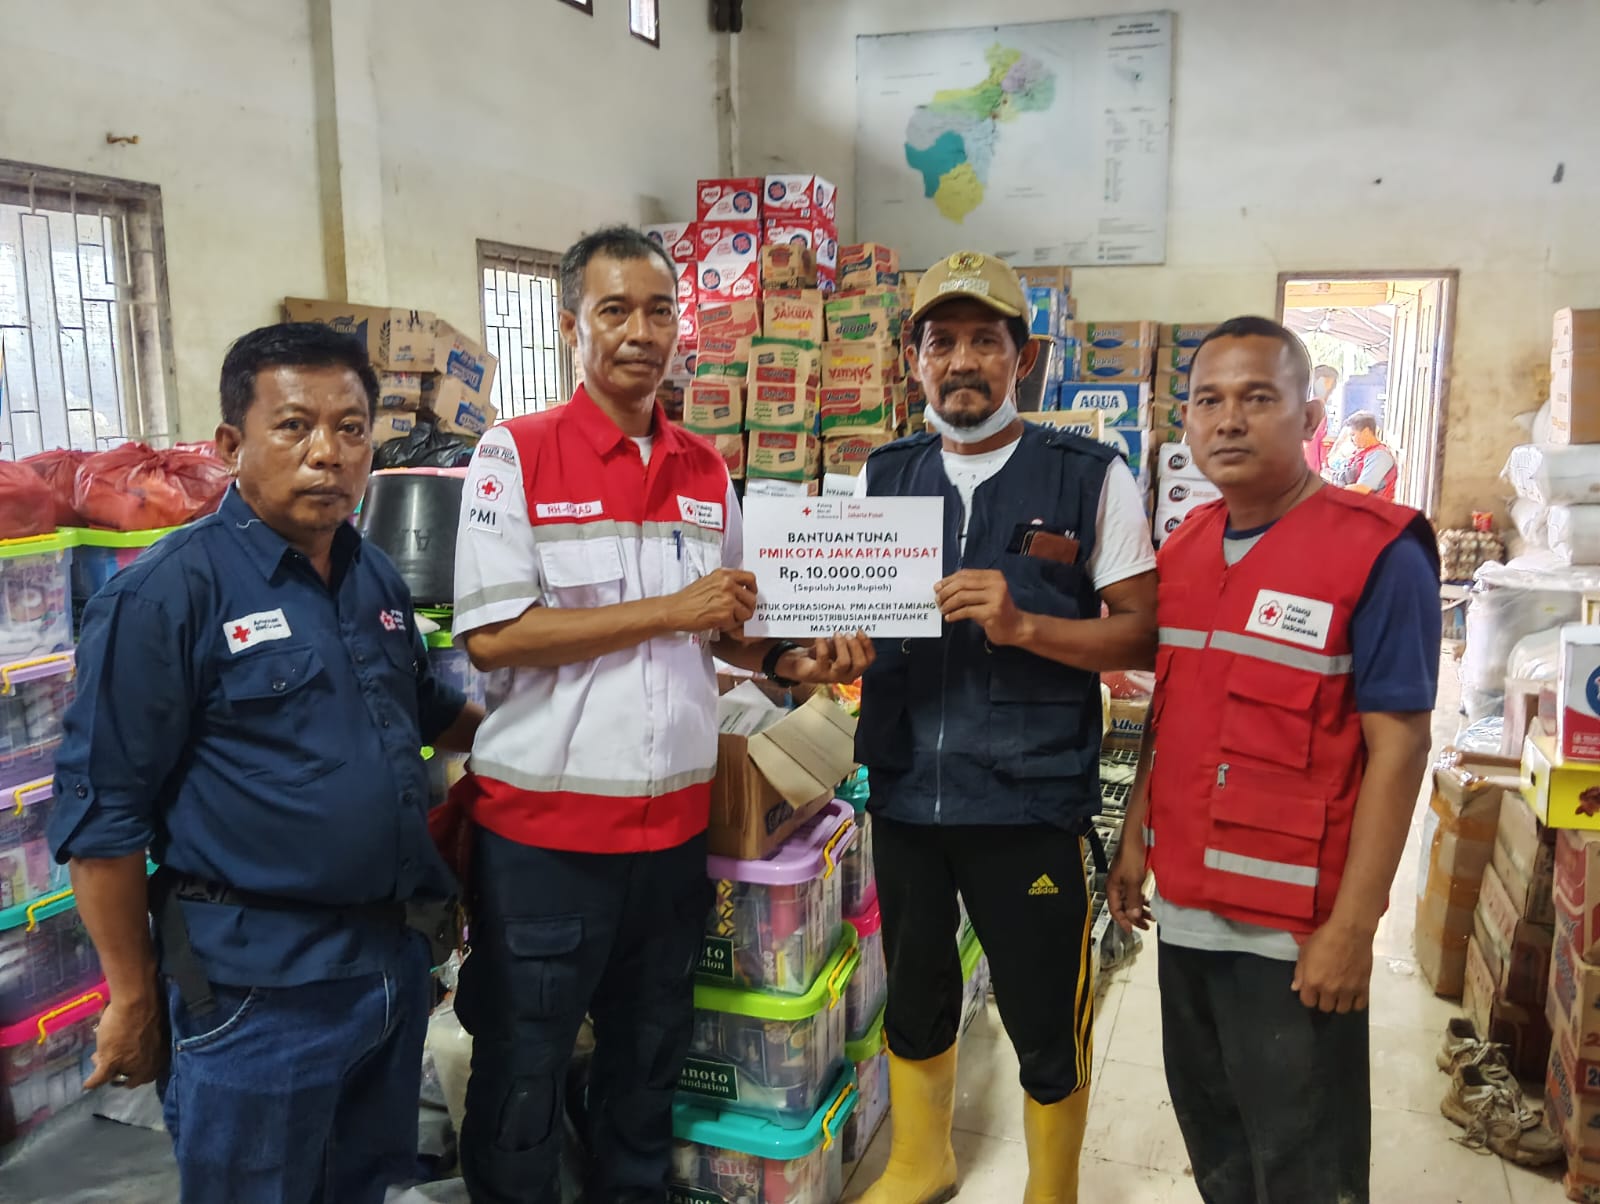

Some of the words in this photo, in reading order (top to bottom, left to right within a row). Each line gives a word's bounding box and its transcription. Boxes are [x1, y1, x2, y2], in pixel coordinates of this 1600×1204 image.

[1079, 395, 1120, 409] AQUA
[470, 508, 497, 525] PMI
[788, 532, 854, 543] BANTUAN
[856, 532, 898, 543] TUNAI
[759, 548, 783, 559] PMI
[785, 548, 825, 559] KOTA
[827, 548, 892, 559] JAKARTA
[894, 547, 938, 558] PUSAT
[779, 566, 803, 582] Rp.
[806, 566, 898, 579] 10.000.000
[836, 584, 856, 592] Juta
[756, 603, 780, 611] NTUK
[782, 603, 846, 611] OPERASIONAL
[893, 602, 936, 610] TAMIANG
[758, 613, 792, 621] DALAM
[792, 613, 871, 621] PENDISTRIBUSIAN
[871, 613, 916, 621] BANTUAN
[810, 625, 877, 633] MASYARAKAT
[1028, 886, 1059, 895] adidas
